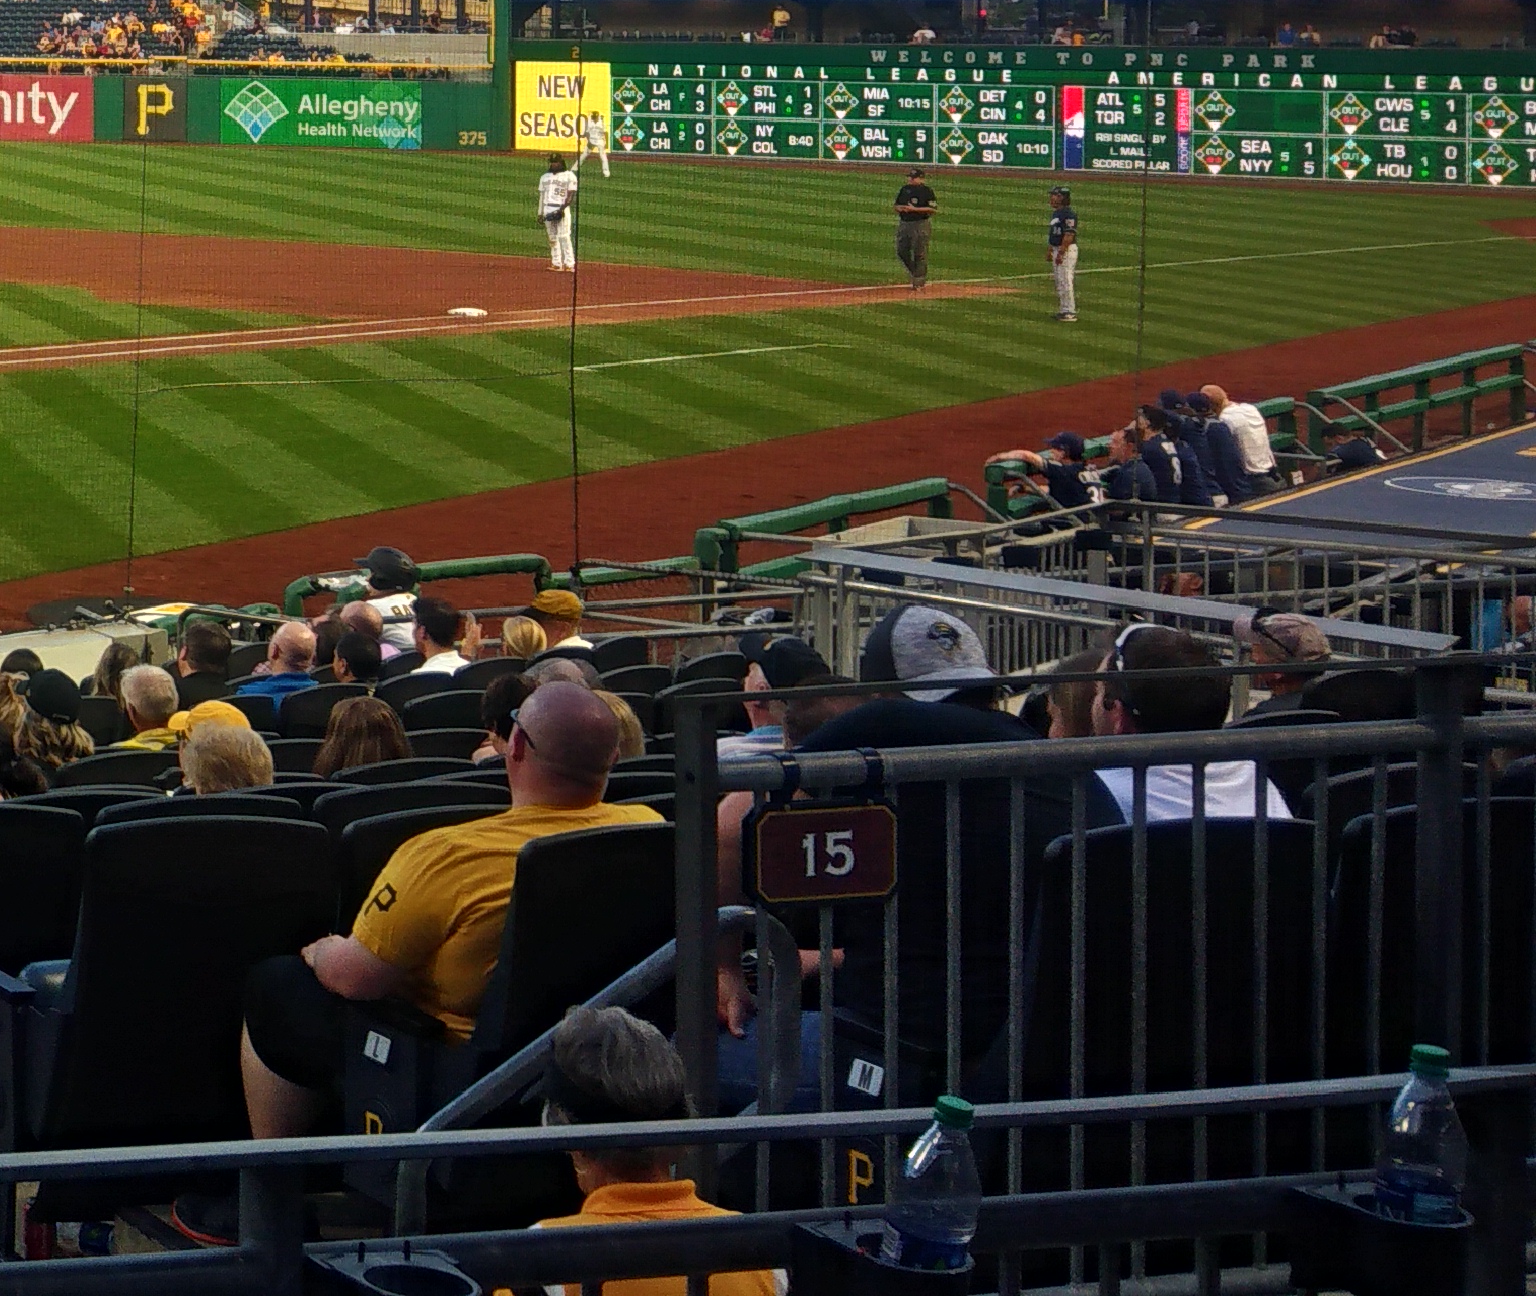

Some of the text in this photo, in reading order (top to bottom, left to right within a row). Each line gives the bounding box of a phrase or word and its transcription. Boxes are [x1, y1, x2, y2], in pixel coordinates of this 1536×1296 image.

[870, 50, 1316, 68] WELCOME TO PNC PARK
[648, 64, 1013, 83] NATIONAL LEAGUE
[537, 74, 587, 100] NEW
[1107, 71, 1536, 92] AMERICAN LEAGU
[653, 82, 669, 95] LA
[753, 85, 777, 98] STL
[863, 87, 890, 100] MIA
[898, 97, 930, 109] 10:15
[979, 90, 1007, 103] DET
[1096, 92, 1124, 106] ATL
[137, 83, 175, 137] P
[297, 93, 420, 122] Allegheny
[650, 99, 671, 111] CHI
[754, 102, 776, 114] PHI
[868, 104, 885, 117] SF
[1375, 97, 1414, 112] CWS
[980, 107, 1006, 120] CIN
[1095, 110, 1125, 124] TOR
[297, 123, 418, 140] Health Network
[519, 112, 606, 138] SEASO
[653, 121, 669, 134] LA
[755, 125, 775, 137] NY
[1379, 117, 1410, 133] CLE
[458, 131, 488, 147] 375
[788, 135, 813, 146] 8:40
[863, 128, 889, 141] BAL
[978, 132, 1009, 145] OAK
[1095, 133, 1167, 144] RBI SINGL BY
[650, 138, 671, 150] CHI
[753, 141, 778, 154] COL
[1016, 142, 1049, 155] 10:10
[1241, 140, 1272, 154] SEA
[861, 145, 892, 158] WSH
[982, 150, 1004, 163] SD
[1384, 144, 1406, 159] TB
[1092, 158, 1133, 170] SCORED
[1239, 159, 1273, 173] NYY
[1376, 163, 1413, 178] HOU
[800, 829, 856, 878] 15
[364, 881, 397, 918] P
[846, 1148, 875, 1205] P
